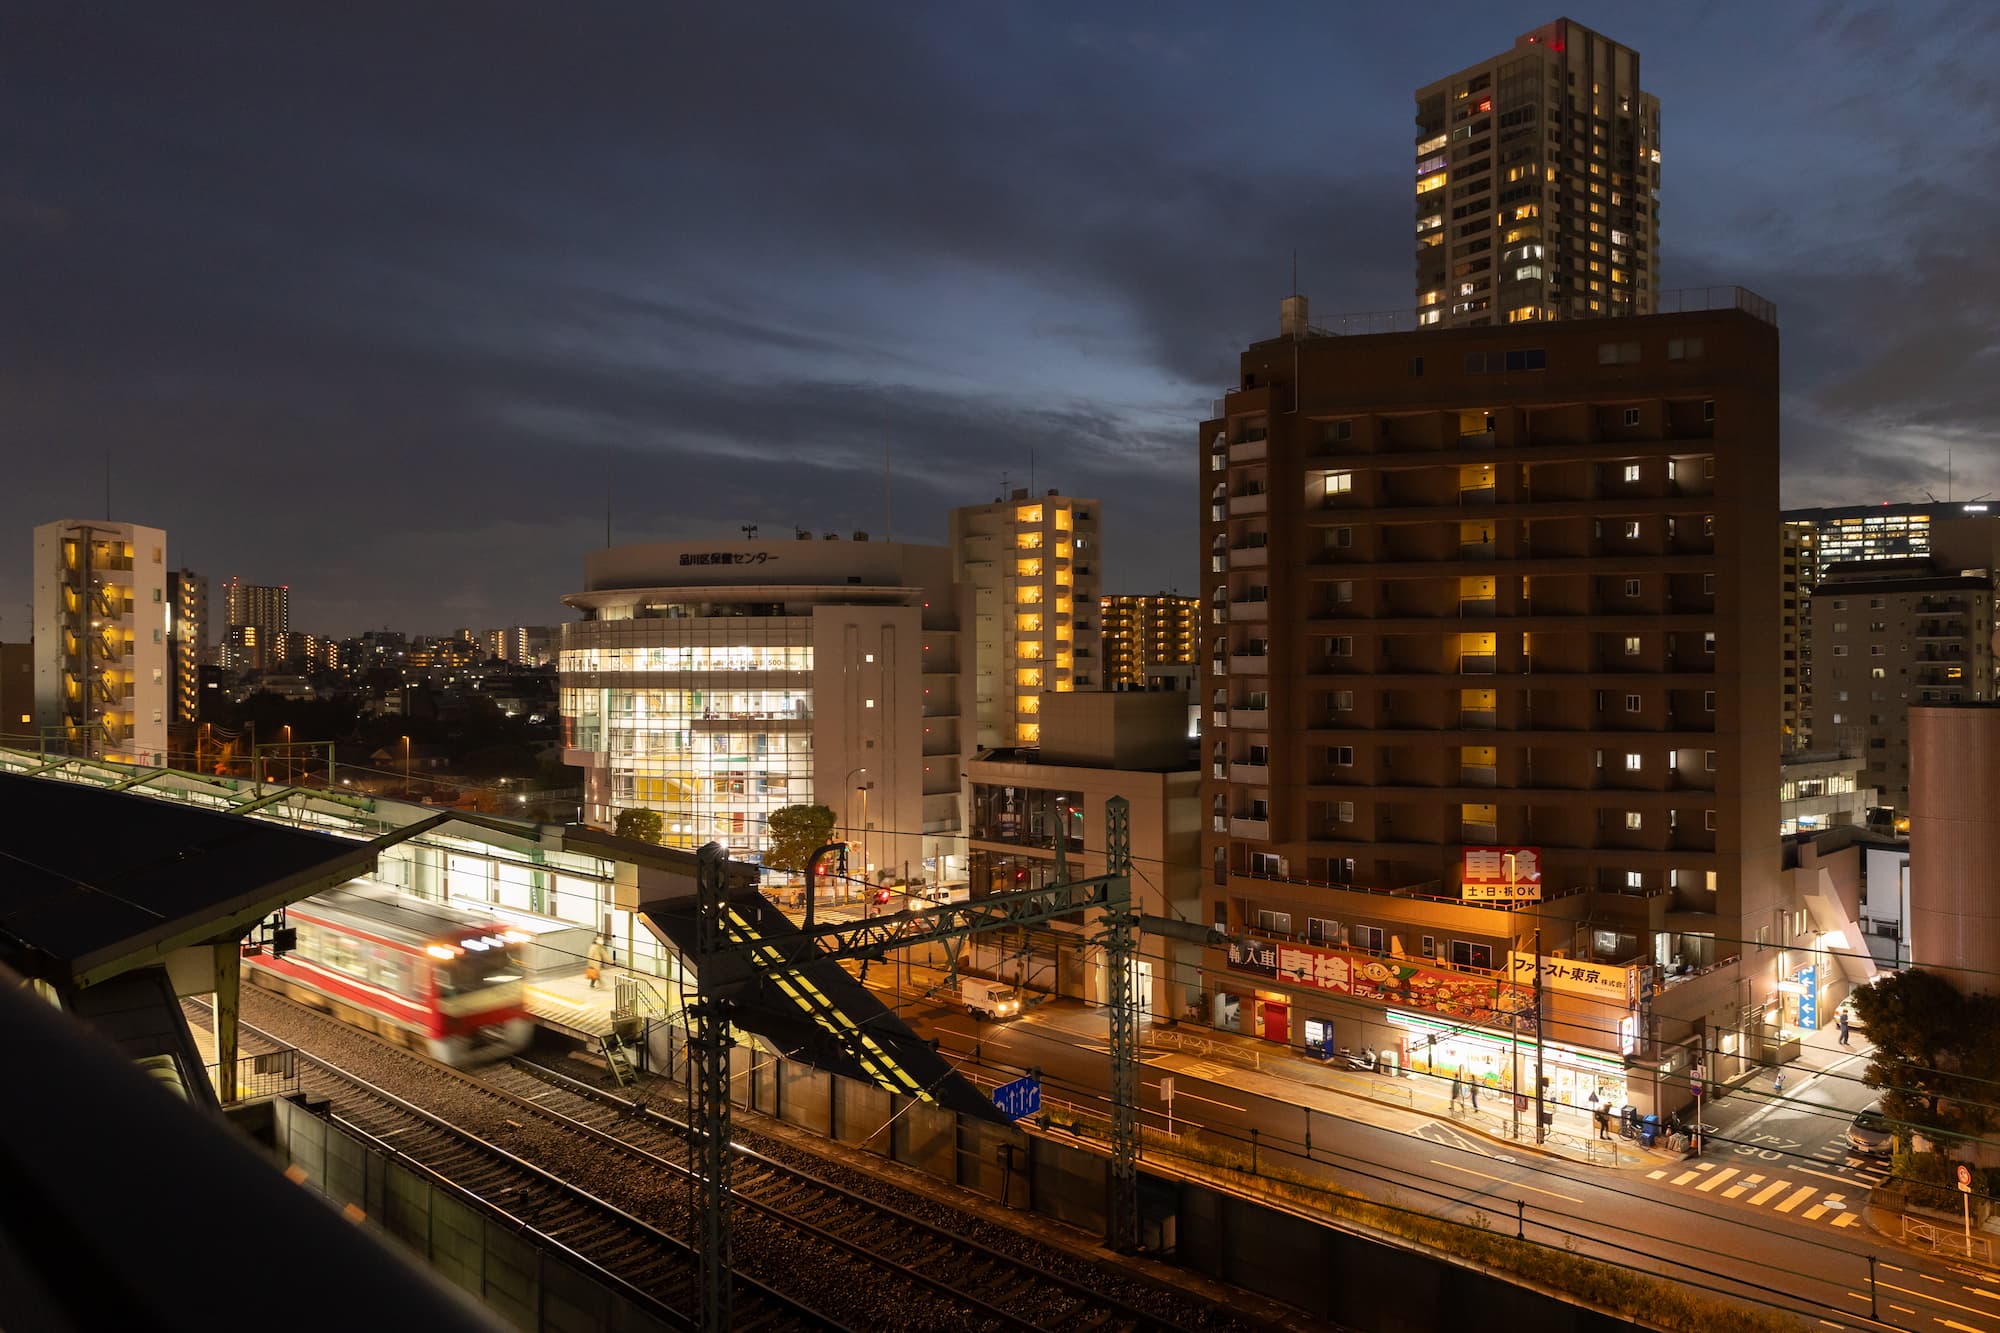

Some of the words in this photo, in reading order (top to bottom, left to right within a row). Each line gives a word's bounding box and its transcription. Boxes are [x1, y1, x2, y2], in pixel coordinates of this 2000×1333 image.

[1466, 850, 1536, 882] 車検
[1228, 944, 1275, 969] 輸入車
[1281, 949, 1349, 991] 車検
[1515, 958, 1600, 984] ファースト東京
[1734, 1144, 1783, 1161] 30
